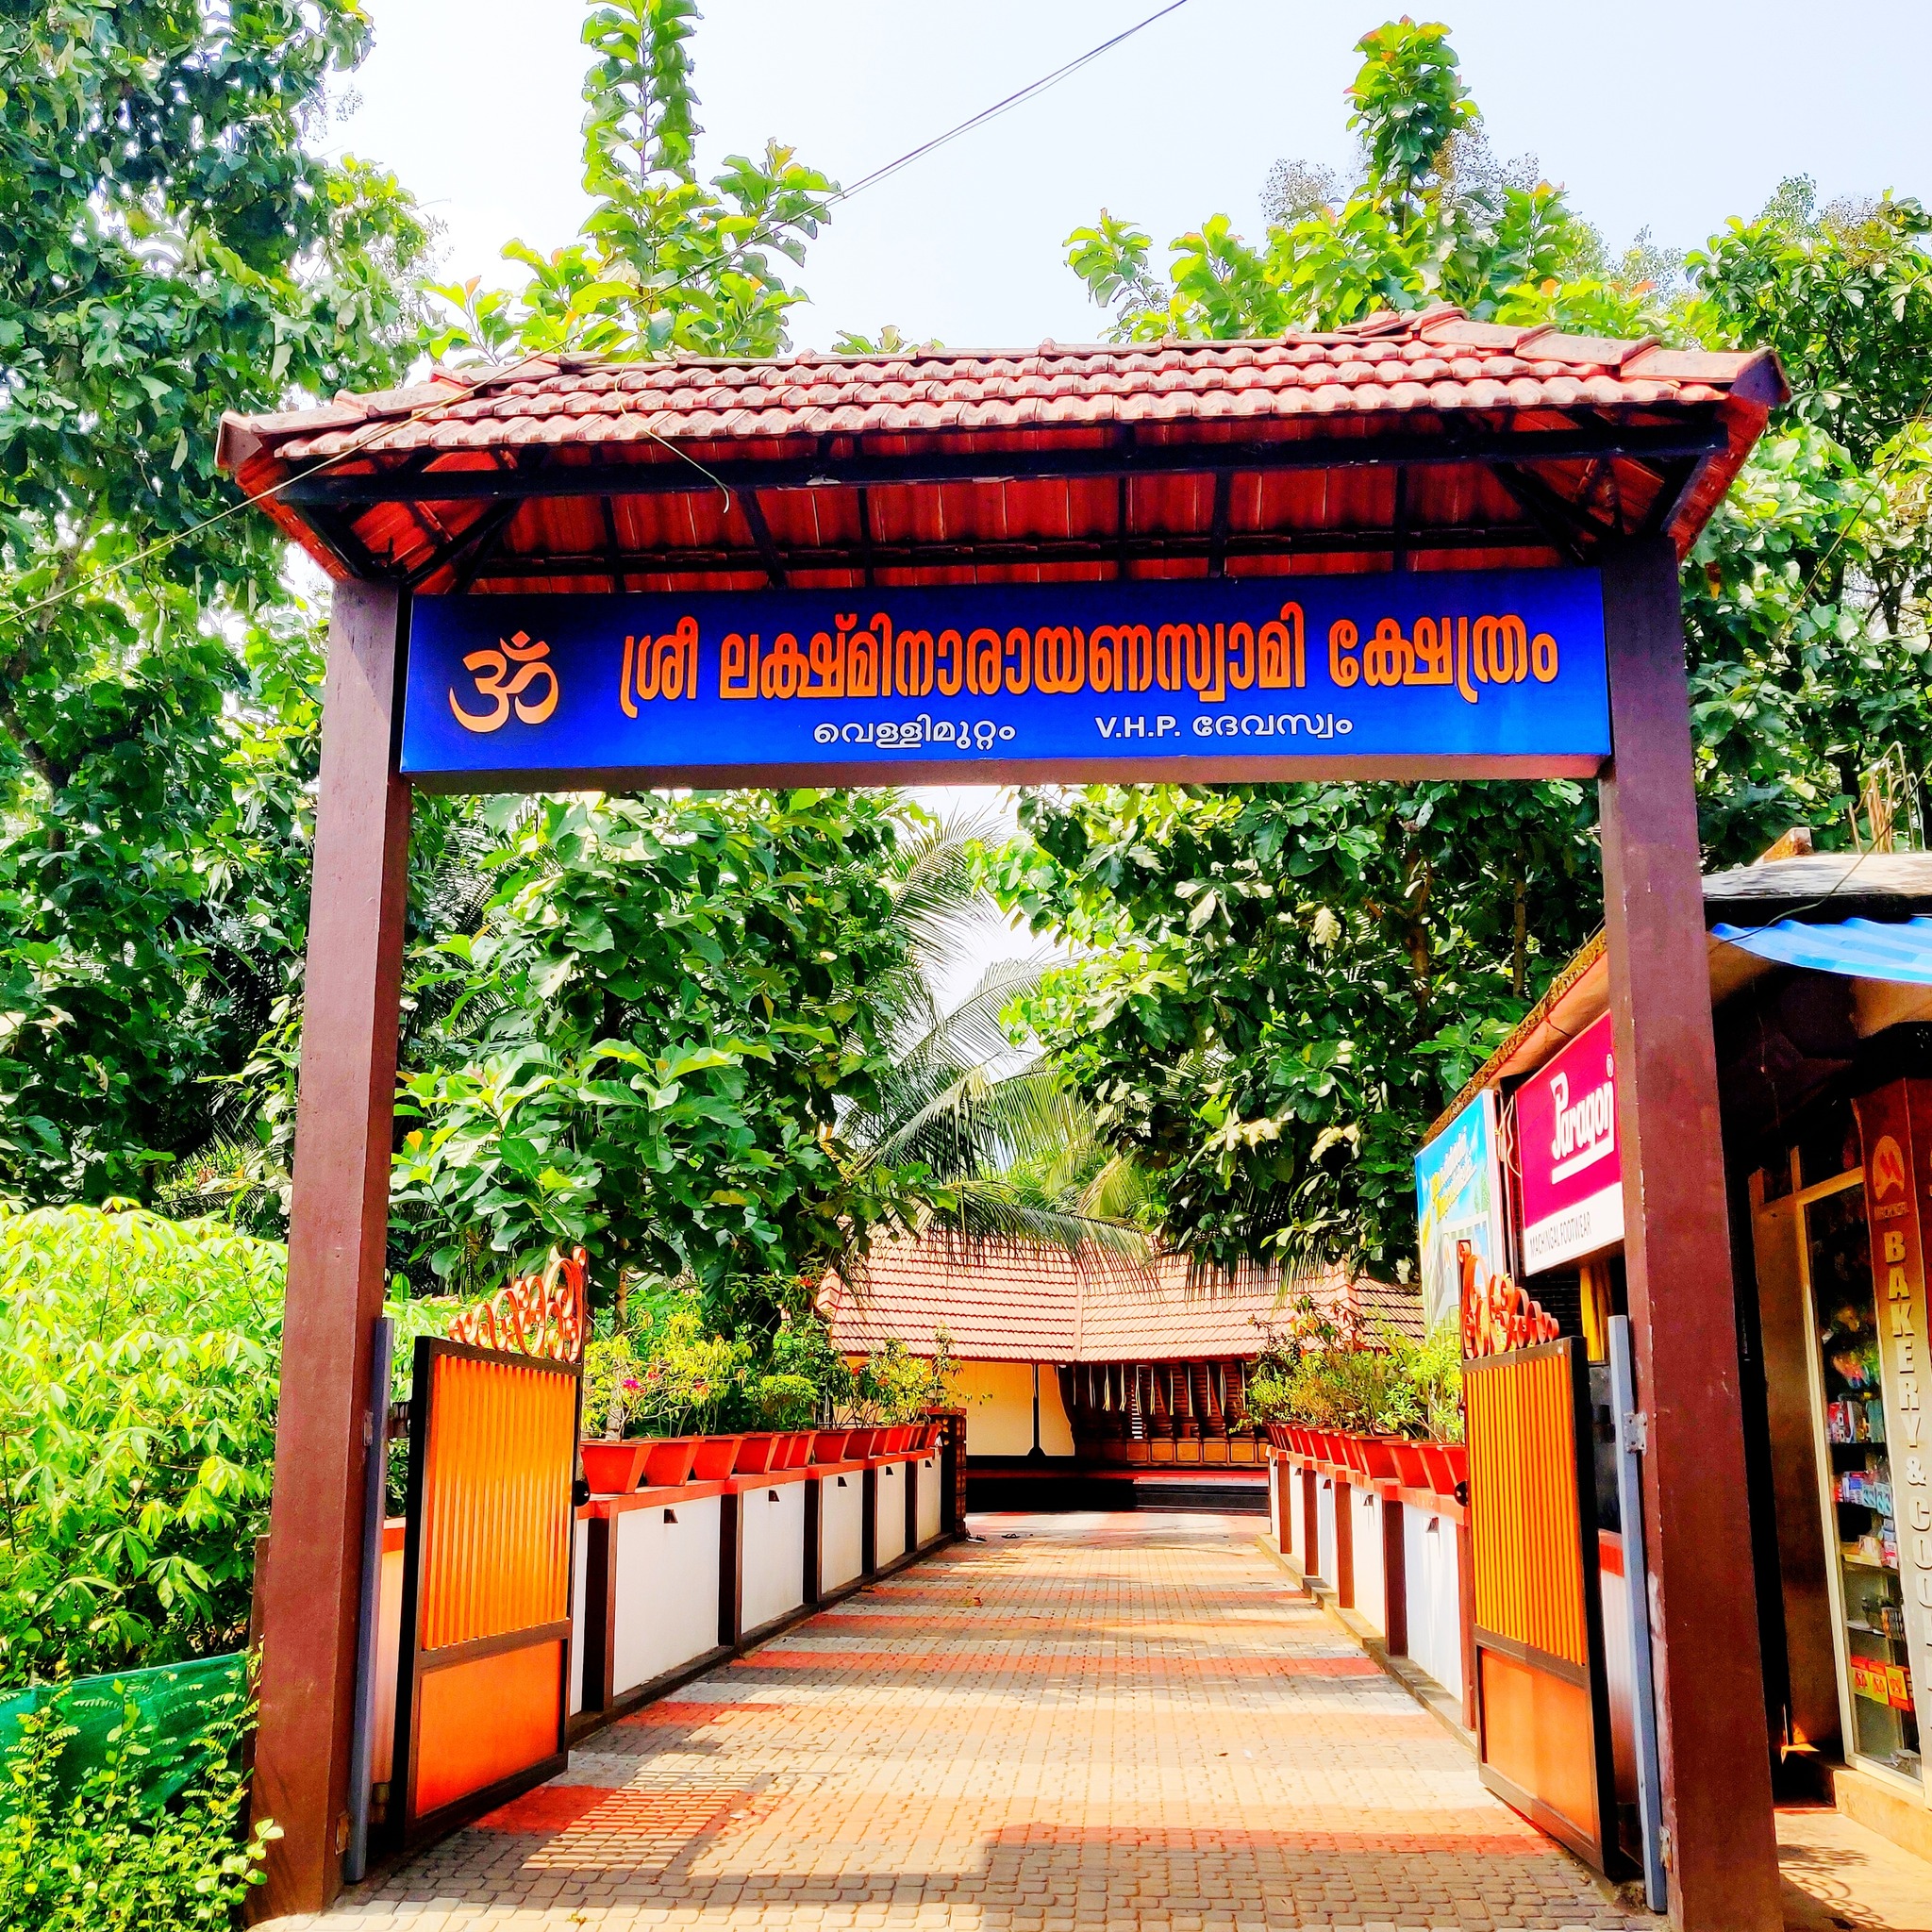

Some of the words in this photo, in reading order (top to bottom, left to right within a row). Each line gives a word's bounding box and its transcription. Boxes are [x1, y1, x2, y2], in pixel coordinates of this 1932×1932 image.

[620, 616, 699, 719] ശ്രീ
[1328, 615, 1559, 704] ക്ഷേത്രം
[814, 713, 1016, 750] വെള്ളിമുറ്റം
[1095, 715, 1181, 739] V.H.P.
[1192, 714, 1354, 739] ദേവസ്വം
[1550, 1071, 1614, 1162] Paragon
[1559, 1210, 1592, 1246] FOOTWEAR
[1884, 1230, 1921, 1448] BAKERY
[1906, 1457, 1926, 1486] &
